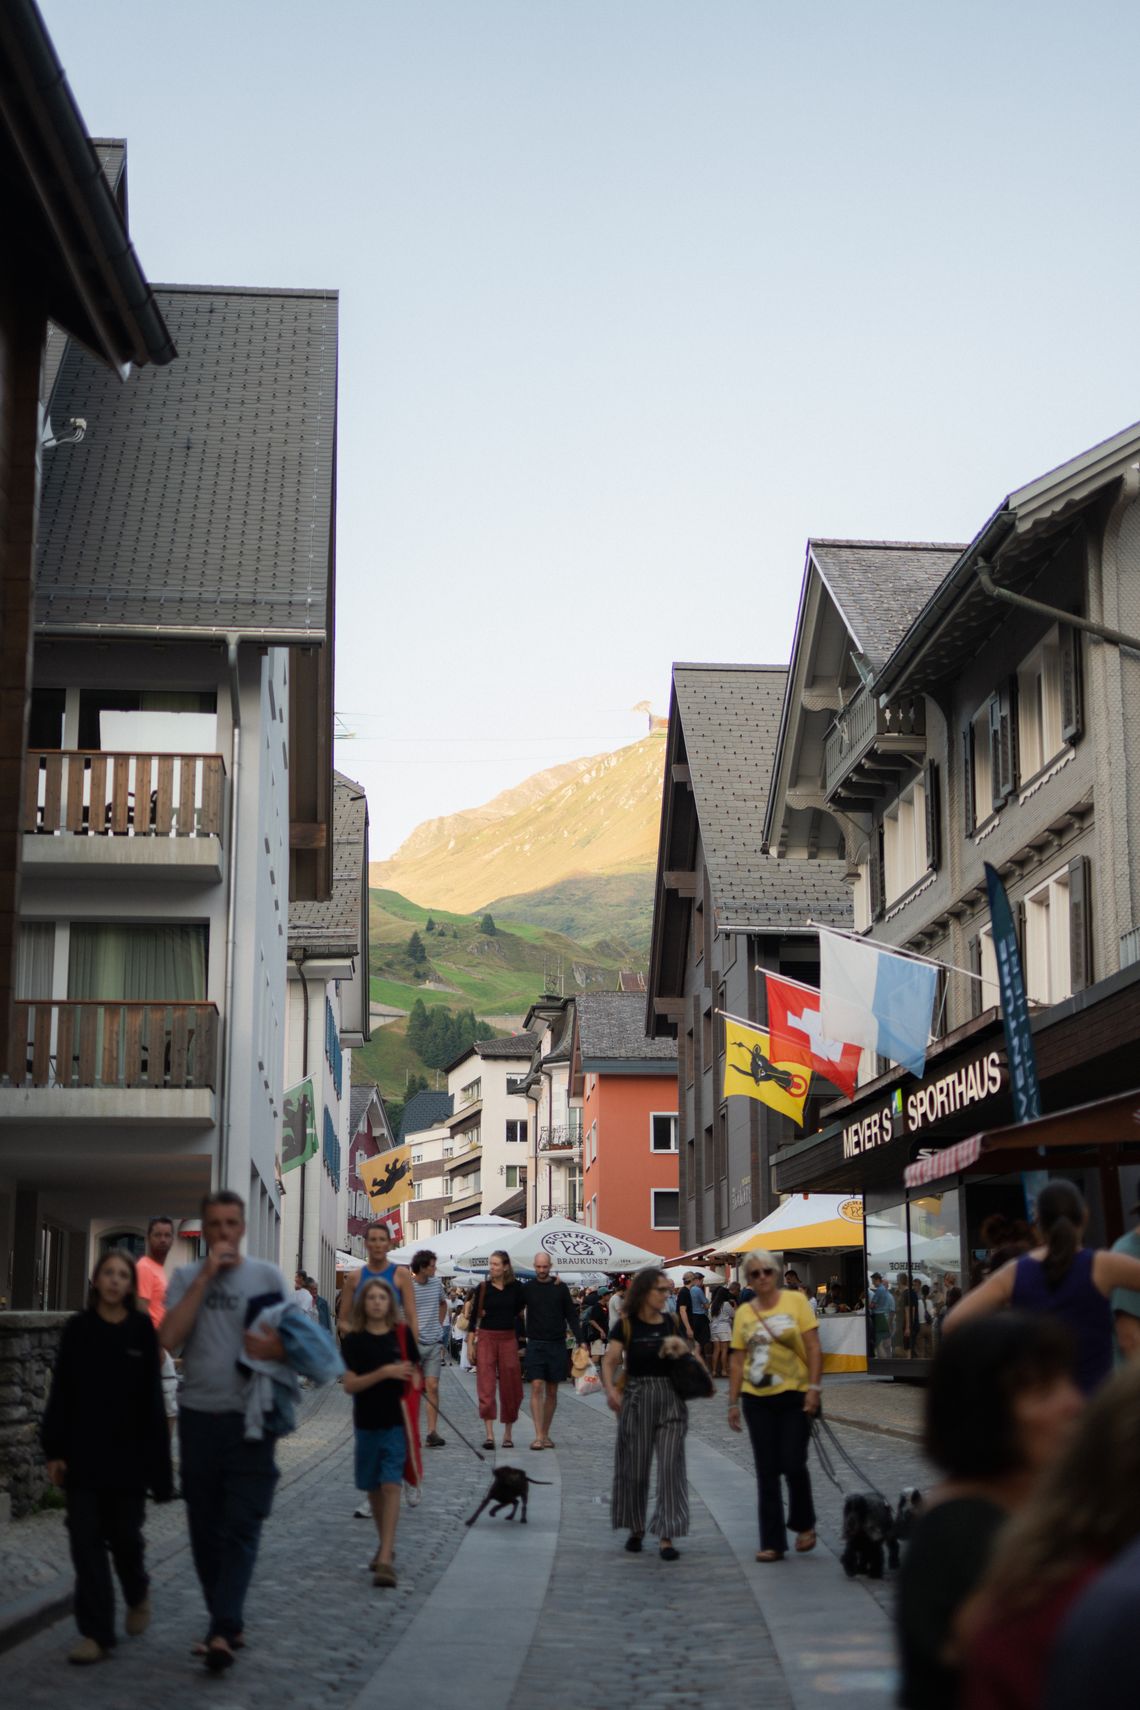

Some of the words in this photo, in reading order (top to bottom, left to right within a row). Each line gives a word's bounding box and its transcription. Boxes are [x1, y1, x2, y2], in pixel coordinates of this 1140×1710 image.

[843, 1107, 892, 1159] MEYER'S
[907, 1052, 1001, 1131] SPORTHAUS
[1023, 1033, 1040, 1118] ARTS
[545, 1232, 603, 1245] EICHHOF
